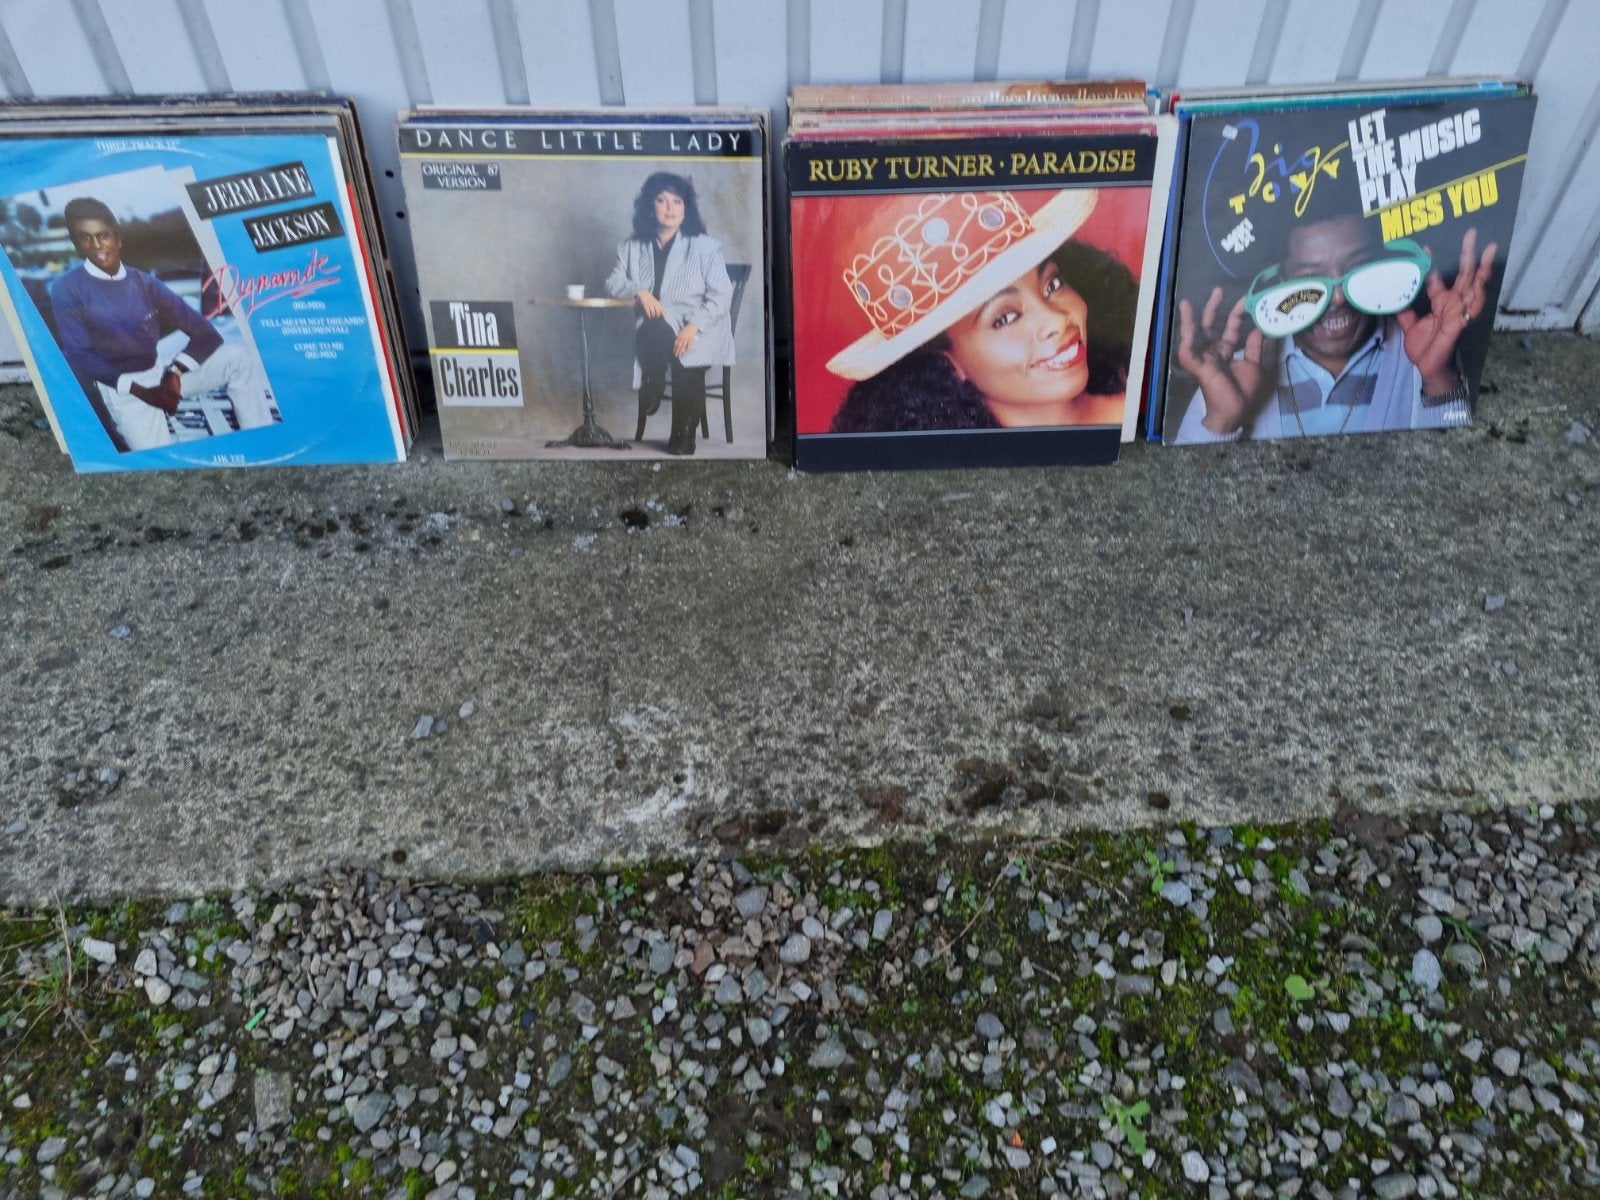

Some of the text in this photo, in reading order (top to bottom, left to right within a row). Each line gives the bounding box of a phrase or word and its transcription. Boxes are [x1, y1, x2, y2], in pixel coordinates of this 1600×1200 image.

[416, 129, 741, 151] DANCE LITTLE LADY
[1348, 107, 1386, 152] LET
[1352, 107, 1481, 182] THE MUSIC
[422, 163, 478, 176] ORIGINAL
[437, 176, 487, 189] VERSION
[808, 149, 1136, 181] RUBY TURNER PARADISE
[205, 166, 312, 212] JERMAINE
[1360, 163, 1417, 214] PLAY
[1380, 170, 1498, 243] MISS YOU
[251, 208, 331, 248] JACKSON
[449, 301, 500, 347] Tina
[440, 356, 519, 398] Charles
